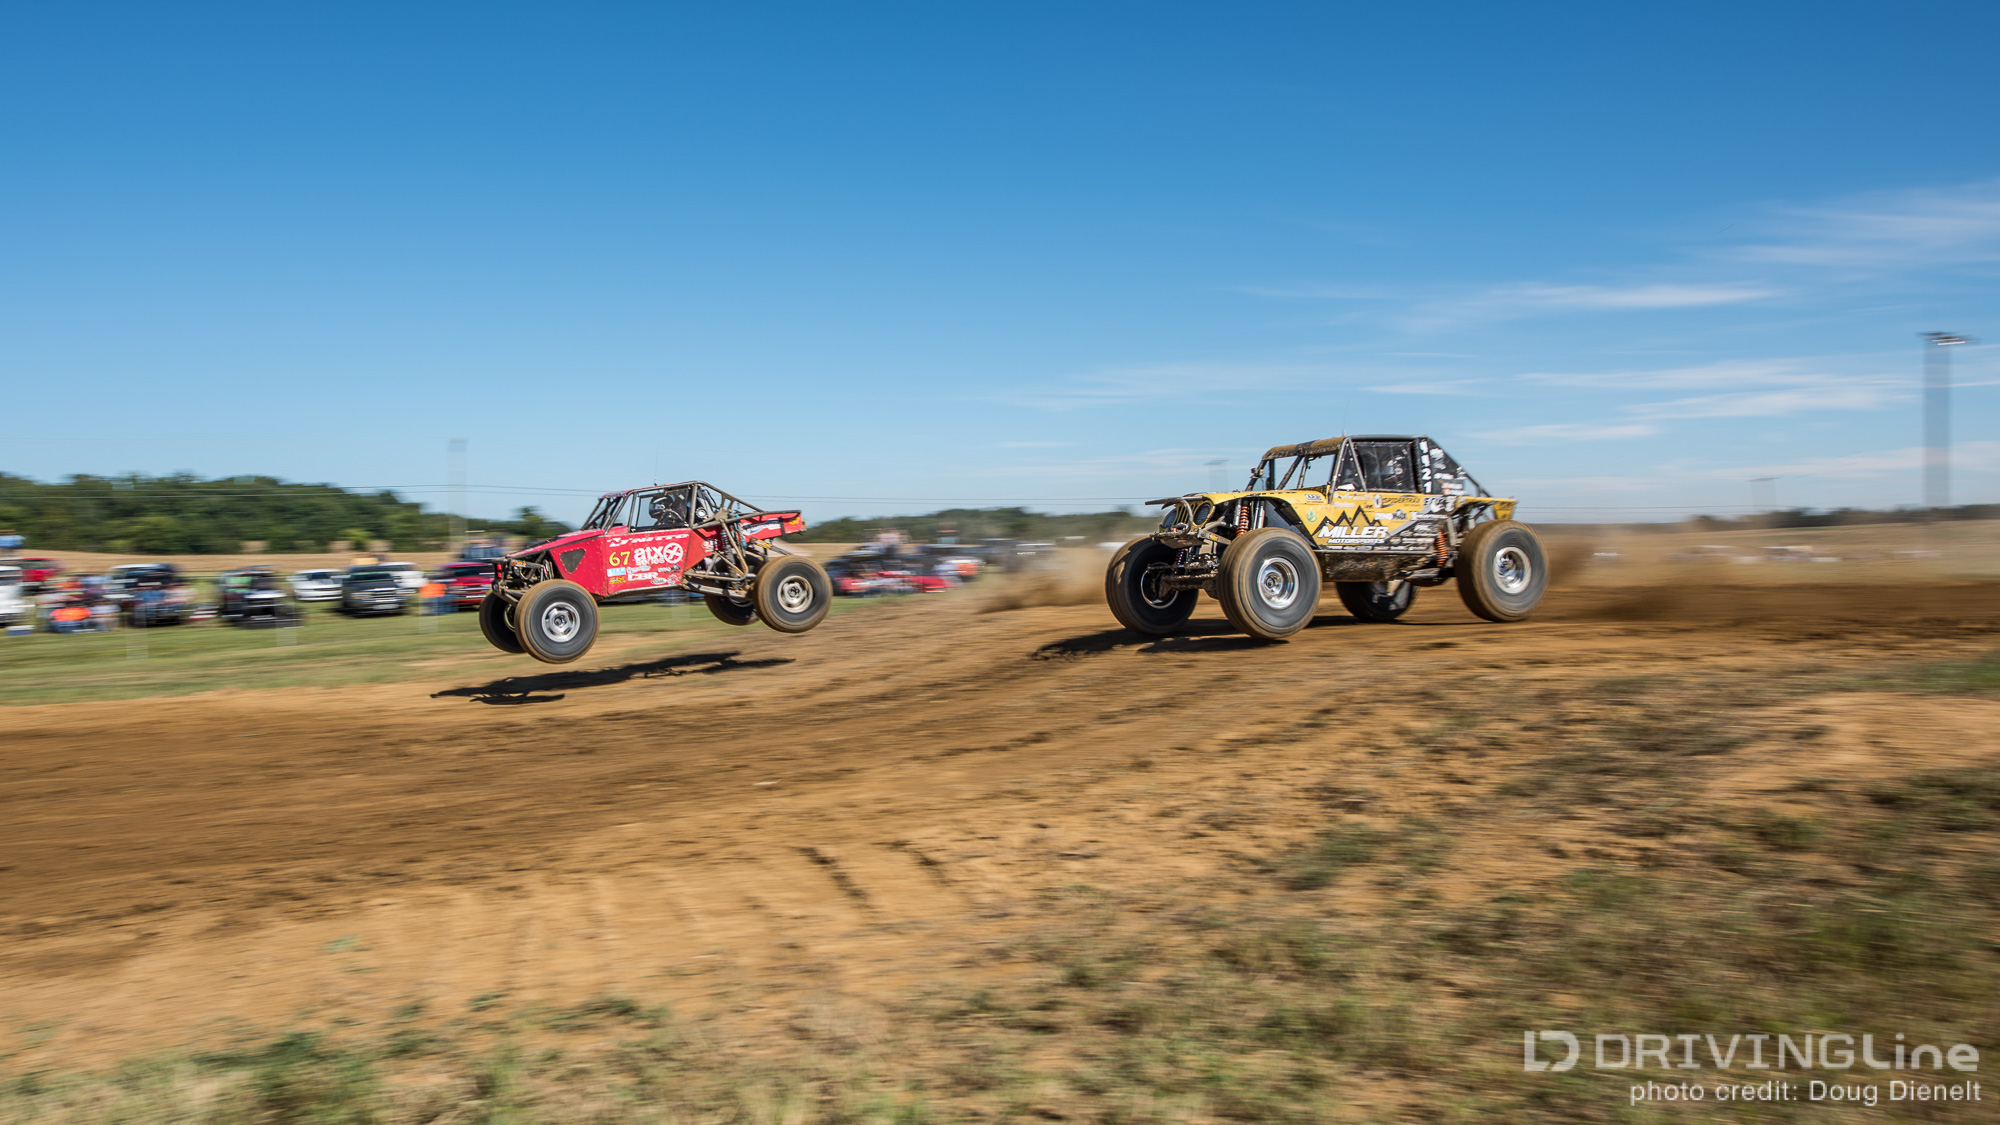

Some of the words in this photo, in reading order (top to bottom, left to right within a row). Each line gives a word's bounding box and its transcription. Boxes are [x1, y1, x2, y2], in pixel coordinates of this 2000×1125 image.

[631, 533, 690, 544] NITTO
[1318, 526, 1389, 539] MILLER
[609, 551, 631, 567] 67
[634, 546, 664, 562] atx
[627, 571, 659, 582] CBR
